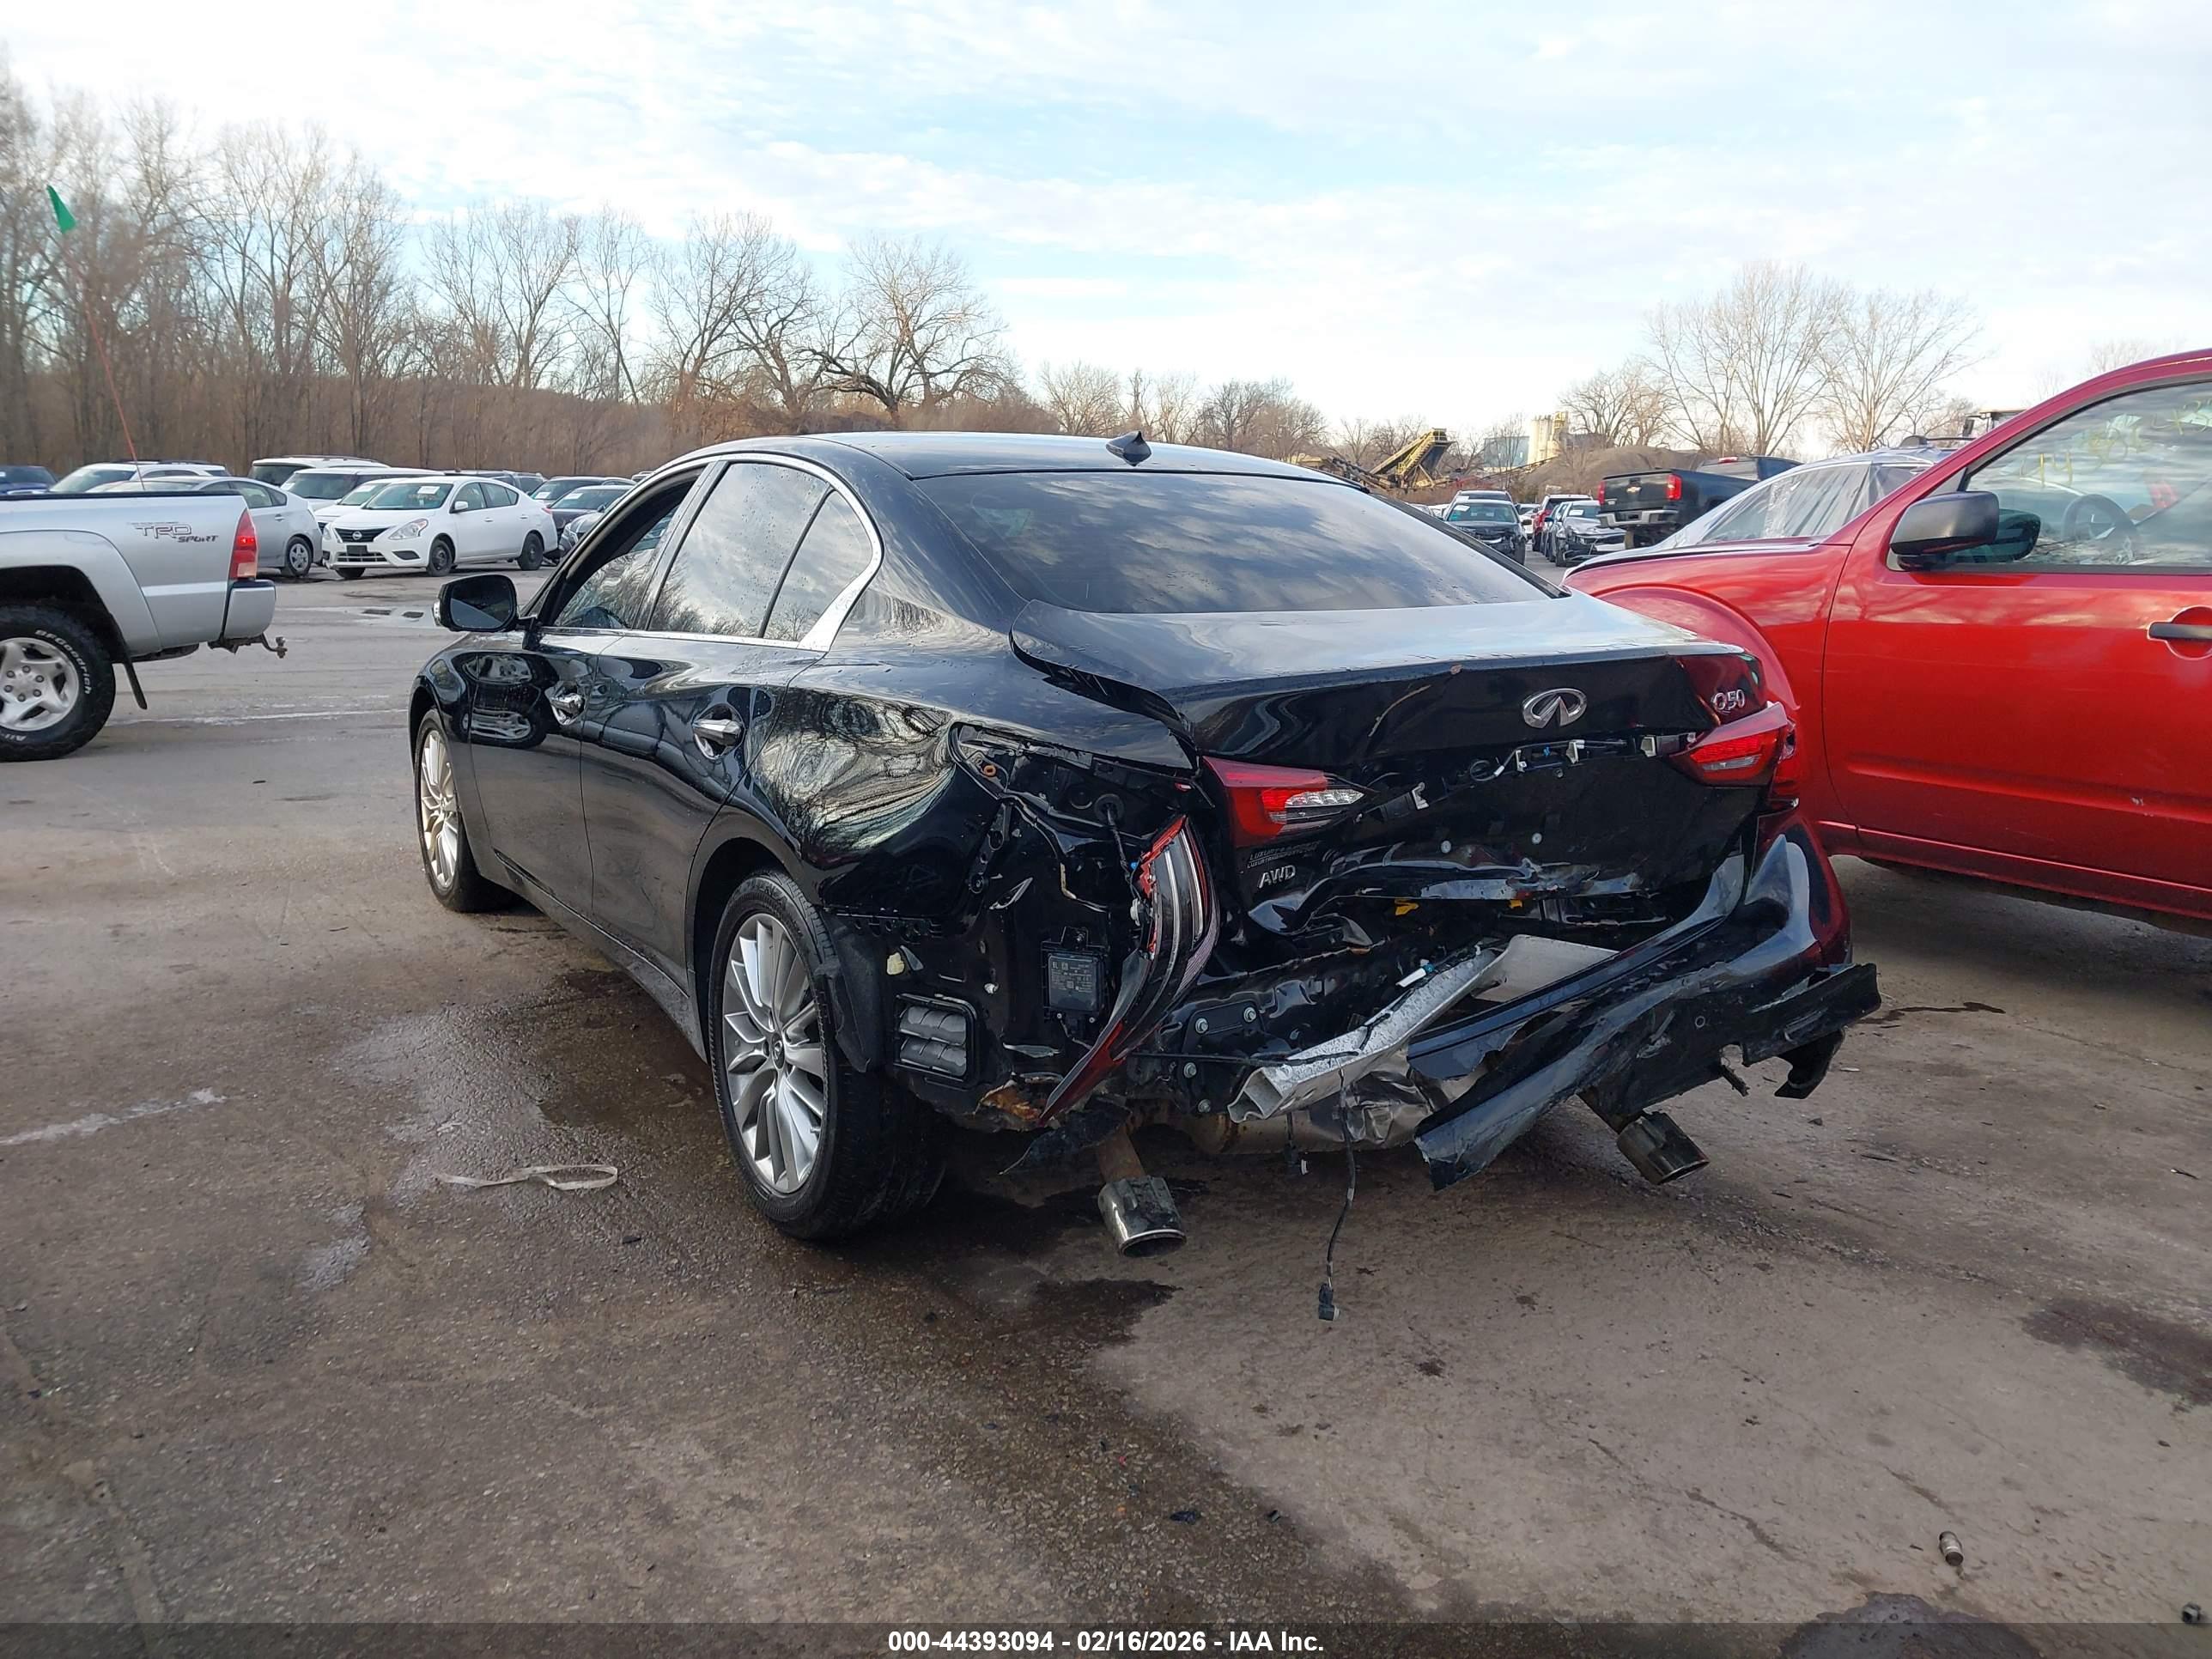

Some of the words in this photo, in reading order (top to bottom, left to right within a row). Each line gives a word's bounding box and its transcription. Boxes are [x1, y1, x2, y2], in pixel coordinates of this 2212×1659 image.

[135, 524, 192, 539] TRD
[1712, 690, 1745, 714] Q50
[1256, 865, 1297, 889] AWD
